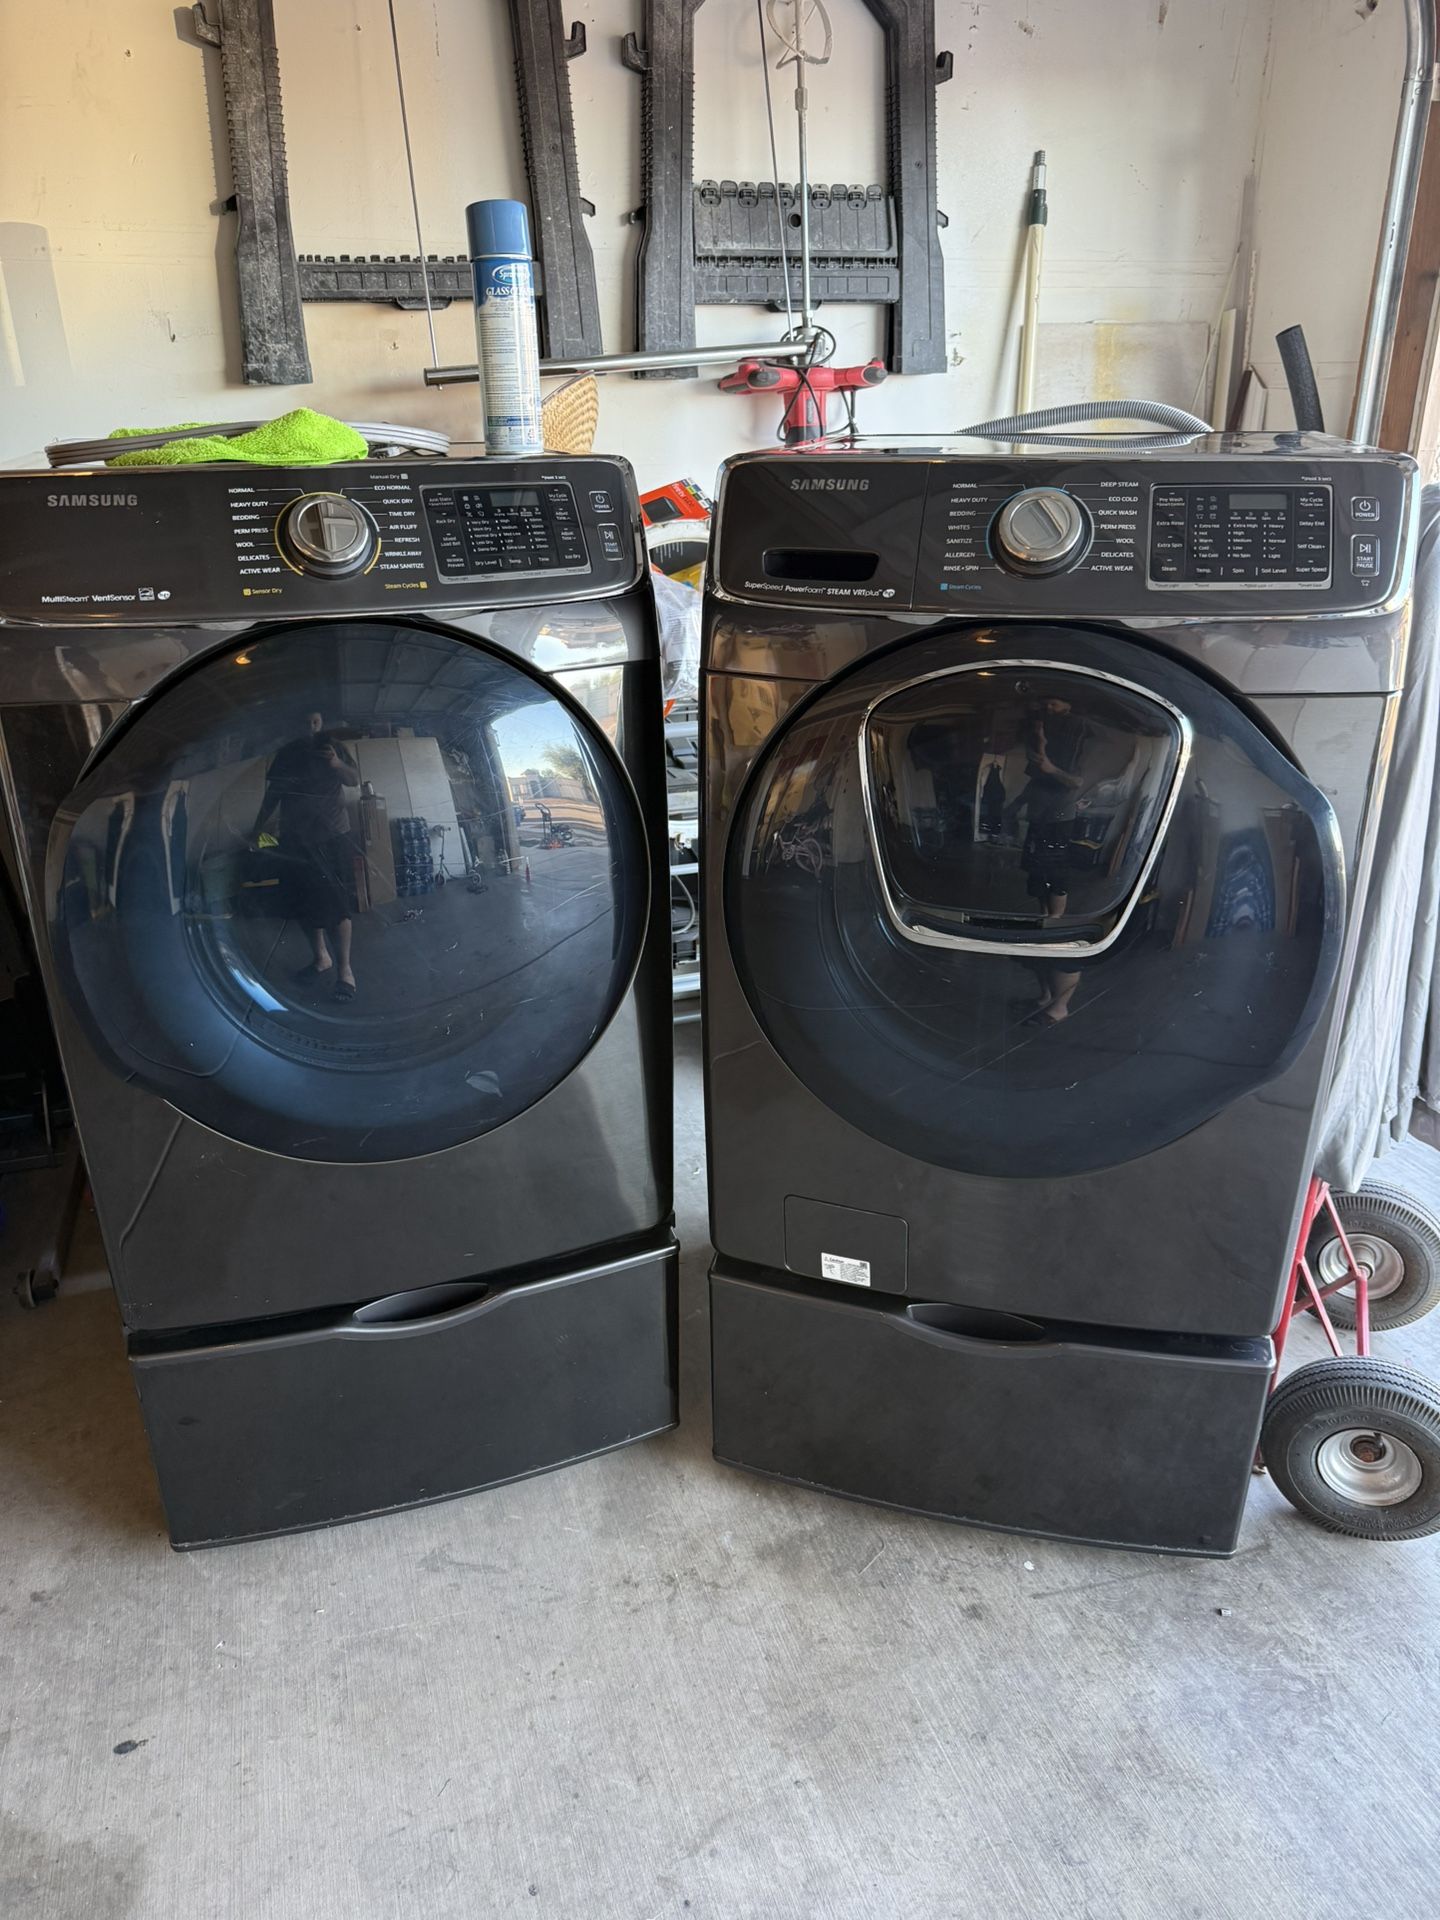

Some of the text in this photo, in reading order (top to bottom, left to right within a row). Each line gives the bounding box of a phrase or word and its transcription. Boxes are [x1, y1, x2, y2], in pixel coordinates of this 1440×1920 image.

[486, 287, 510, 296] GLASS
[790, 479, 869, 491] SAMSUNG
[47, 494, 138, 507] SAMSUNG
[744, 581, 783, 591] SuperSpeed
[272, 587, 282, 595] Dry
[92, 594, 136, 602] VentSensor
